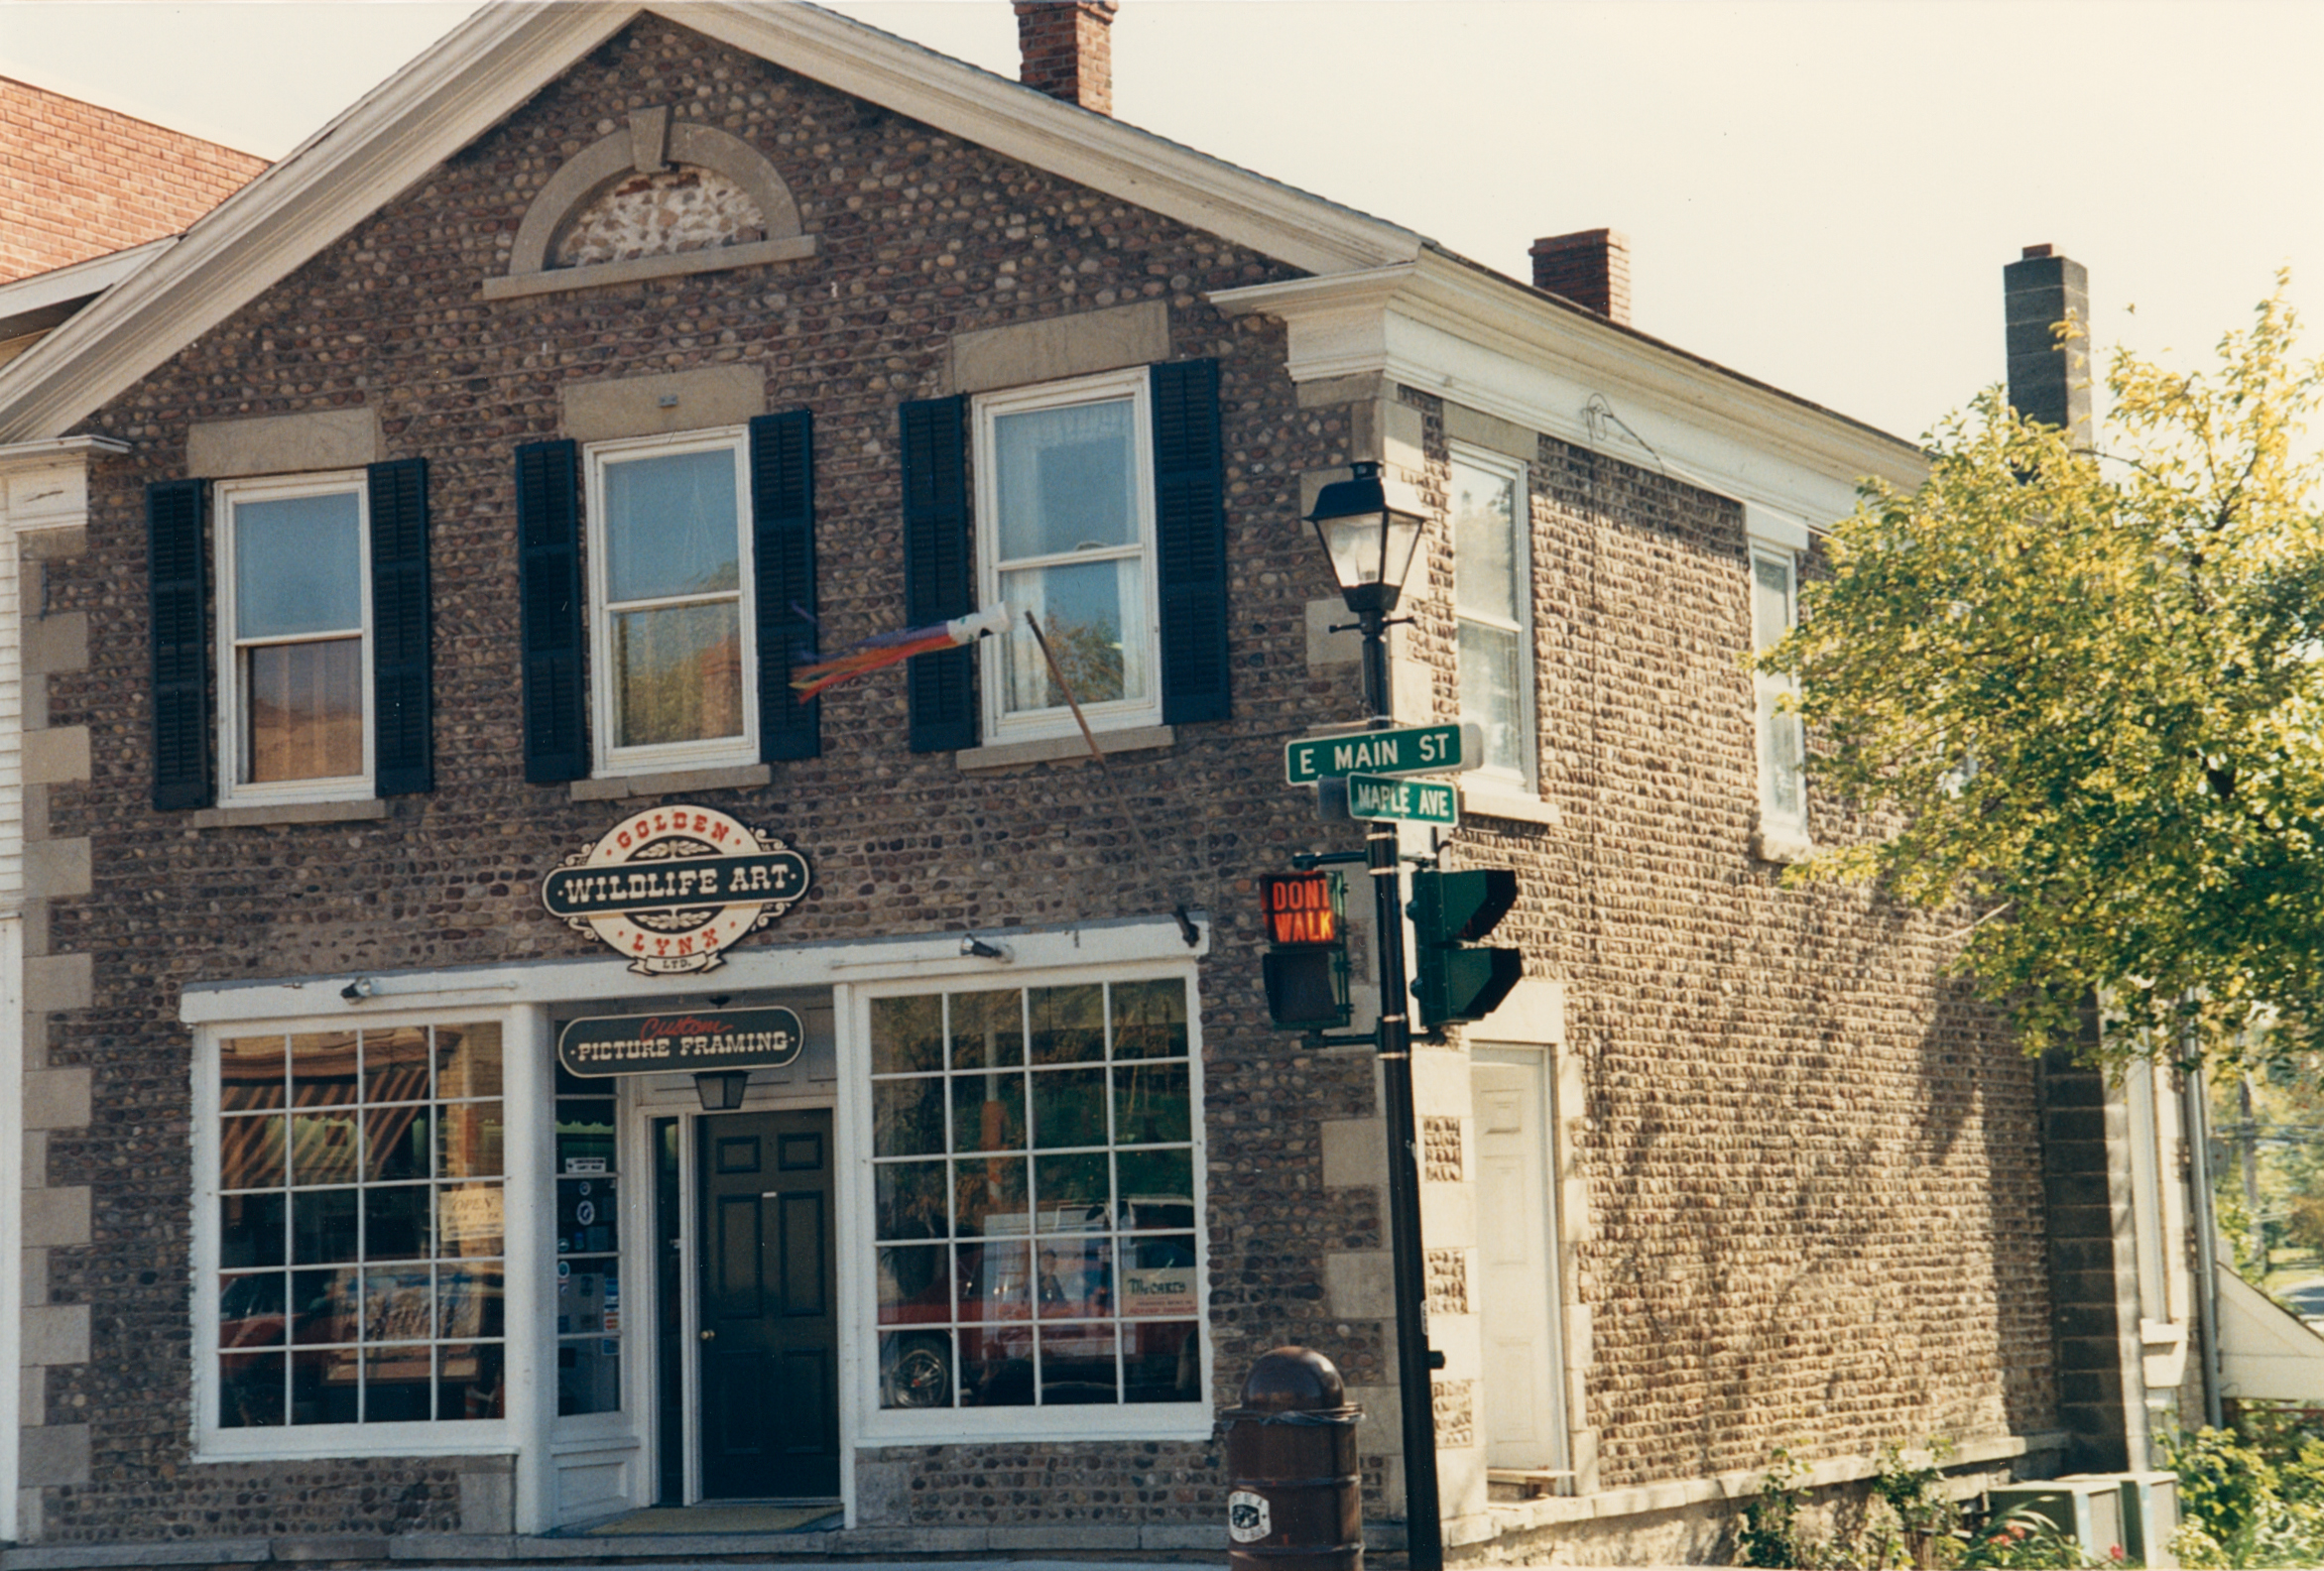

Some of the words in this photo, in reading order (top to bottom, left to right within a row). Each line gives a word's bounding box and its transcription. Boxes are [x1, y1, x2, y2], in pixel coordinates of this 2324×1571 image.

[1299, 749, 1315, 775] E
[1334, 739, 1399, 771] MAIN
[1418, 733, 1449, 762] ST
[1357, 784, 1410, 813] MAPLE
[1418, 789, 1449, 817] AVE
[616, 811, 730, 850] GOLDEN
[564, 868, 718, 904] WILDLIFE
[729, 864, 789, 892] ART
[1273, 879, 1329, 910] DONT
[632, 927, 719, 956] LYNX
[1275, 909, 1334, 942] WALK
[663, 959, 691, 969] LTD.
[640, 1016, 734, 1042] Custom
[577, 1038, 671, 1062] PICTURE
[679, 1031, 789, 1056] FRAMING
